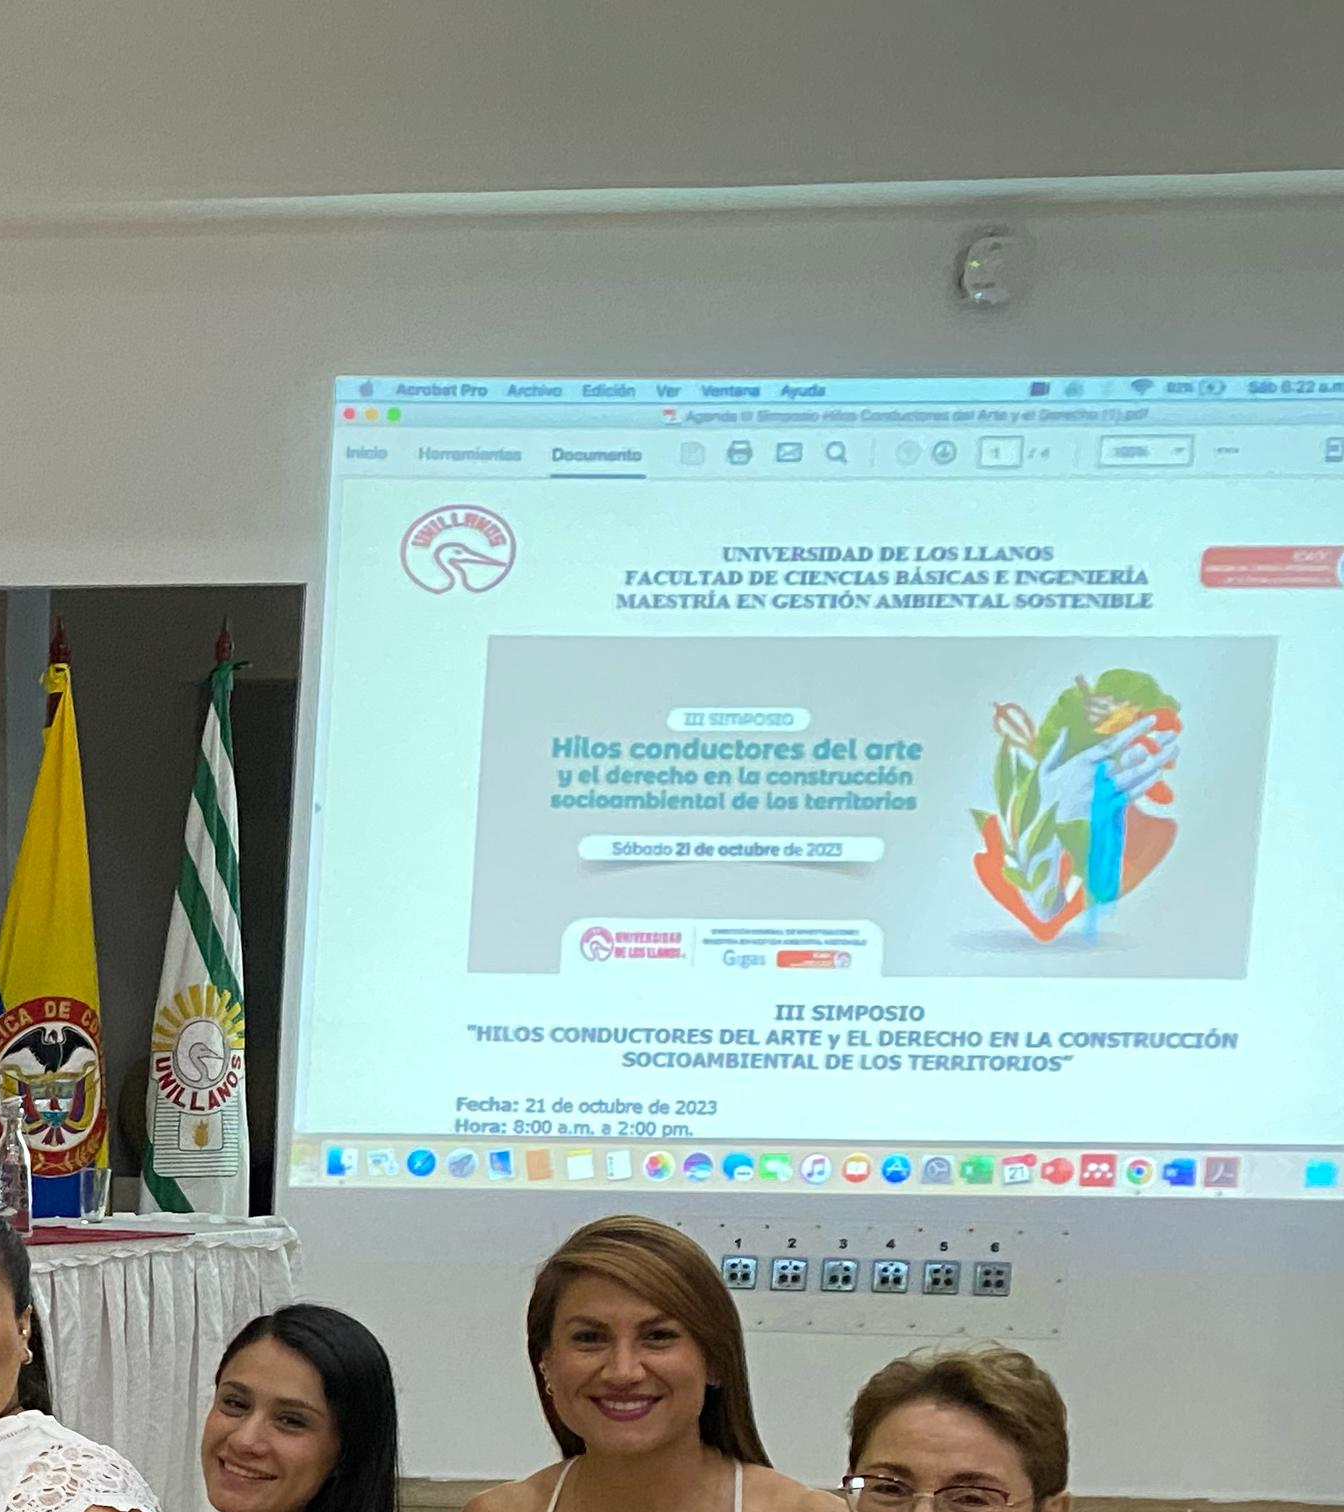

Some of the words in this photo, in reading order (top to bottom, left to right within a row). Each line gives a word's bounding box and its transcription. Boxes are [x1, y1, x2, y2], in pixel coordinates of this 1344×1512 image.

[461, 384, 488, 397] Pro
[507, 383, 562, 397] Archivo
[582, 383, 635, 397] Edición
[656, 384, 681, 397] Ver
[702, 384, 760, 397] Ventana
[781, 384, 826, 399] Ayuda
[722, 546, 874, 562] UNIVERSIDAD
[879, 546, 910, 562] DE
[913, 546, 960, 562] LOS
[962, 546, 1055, 562] LLANOS
[624, 570, 744, 586] FACULTAD
[749, 570, 779, 586] DE
[784, 570, 890, 586] CIENCIAS
[894, 566, 990, 586] BÁSICAS
[995, 570, 1010, 585] E
[1015, 565, 1149, 586] INGENIERÍA
[616, 589, 731, 609] MAESTRÍA
[735, 593, 766, 609] EN
[772, 589, 872, 609] GESTIÓN
[875, 593, 1010, 609] AMBIENTAL
[1014, 593, 1154, 609] SOSTENIBLE
[551, 735, 622, 760] Hilos
[629, 738, 806, 761] conductores
[813, 738, 857, 761] del
[865, 740, 923, 761] arte
[557, 769, 573, 787] y
[578, 766, 600, 784] el
[605, 766, 698, 785] derecho
[704, 770, 732, 785] en
[738, 767, 761, 785] la
[766, 767, 913, 786] construcción
[550, 791, 725, 810] socioambiental
[732, 792, 760, 810] de
[766, 792, 799, 810] los
[804, 792, 917, 811] territorios
[611, 841, 673, 857] Sábado
[675, 842, 691, 856] 21
[694, 841, 715, 857] de
[718, 842, 780, 857] octubre
[783, 842, 803, 857] de
[807, 842, 843, 857] 2023
[43, 1000, 71, 1018] DE
[775, 1004, 806, 1021] III
[812, 1005, 926, 1022] SIMPOSIO
[550, 1027, 714, 1045] CONDUCTORES
[719, 1029, 761, 1045] DEL
[765, 1030, 822, 1047] ARTE
[828, 1035, 840, 1050] y
[847, 1030, 872, 1047] EL
[878, 1030, 983, 1048] DERECHO
[989, 1031, 1020, 1048] EN
[1025, 1031, 1053, 1048] LA
[1058, 1028, 1240, 1050] CONSTRUCCIÓN
[622, 1051, 820, 1070] SOCIOAMBIENTAL
[825, 1054, 854, 1070] DE
[860, 1054, 902, 1071] LOS
[155, 1054, 241, 1112] UNILLANOS
[455, 1097, 518, 1114] Fecha:
[525, 1098, 547, 1114] 21
[552, 1098, 574, 1114] de
[578, 1099, 643, 1115] octubre
[648, 1099, 670, 1115] de
[675, 1100, 718, 1116] 2023
[455, 1118, 507, 1134] Hora:
[513, 1119, 553, 1135] 8:00
[557, 1123, 595, 1136] a.m.
[602, 1123, 612, 1136] a
[617, 1120, 657, 1136] 2:00
[662, 1123, 694, 1137] pm.
[733, 1238, 742, 1249] 1
[787, 1238, 797, 1249] 2
[839, 1238, 848, 1250] 3
[885, 1238, 896, 1250] 4
[939, 1240, 949, 1252] 5
[990, 1242, 1000, 1253] 6
